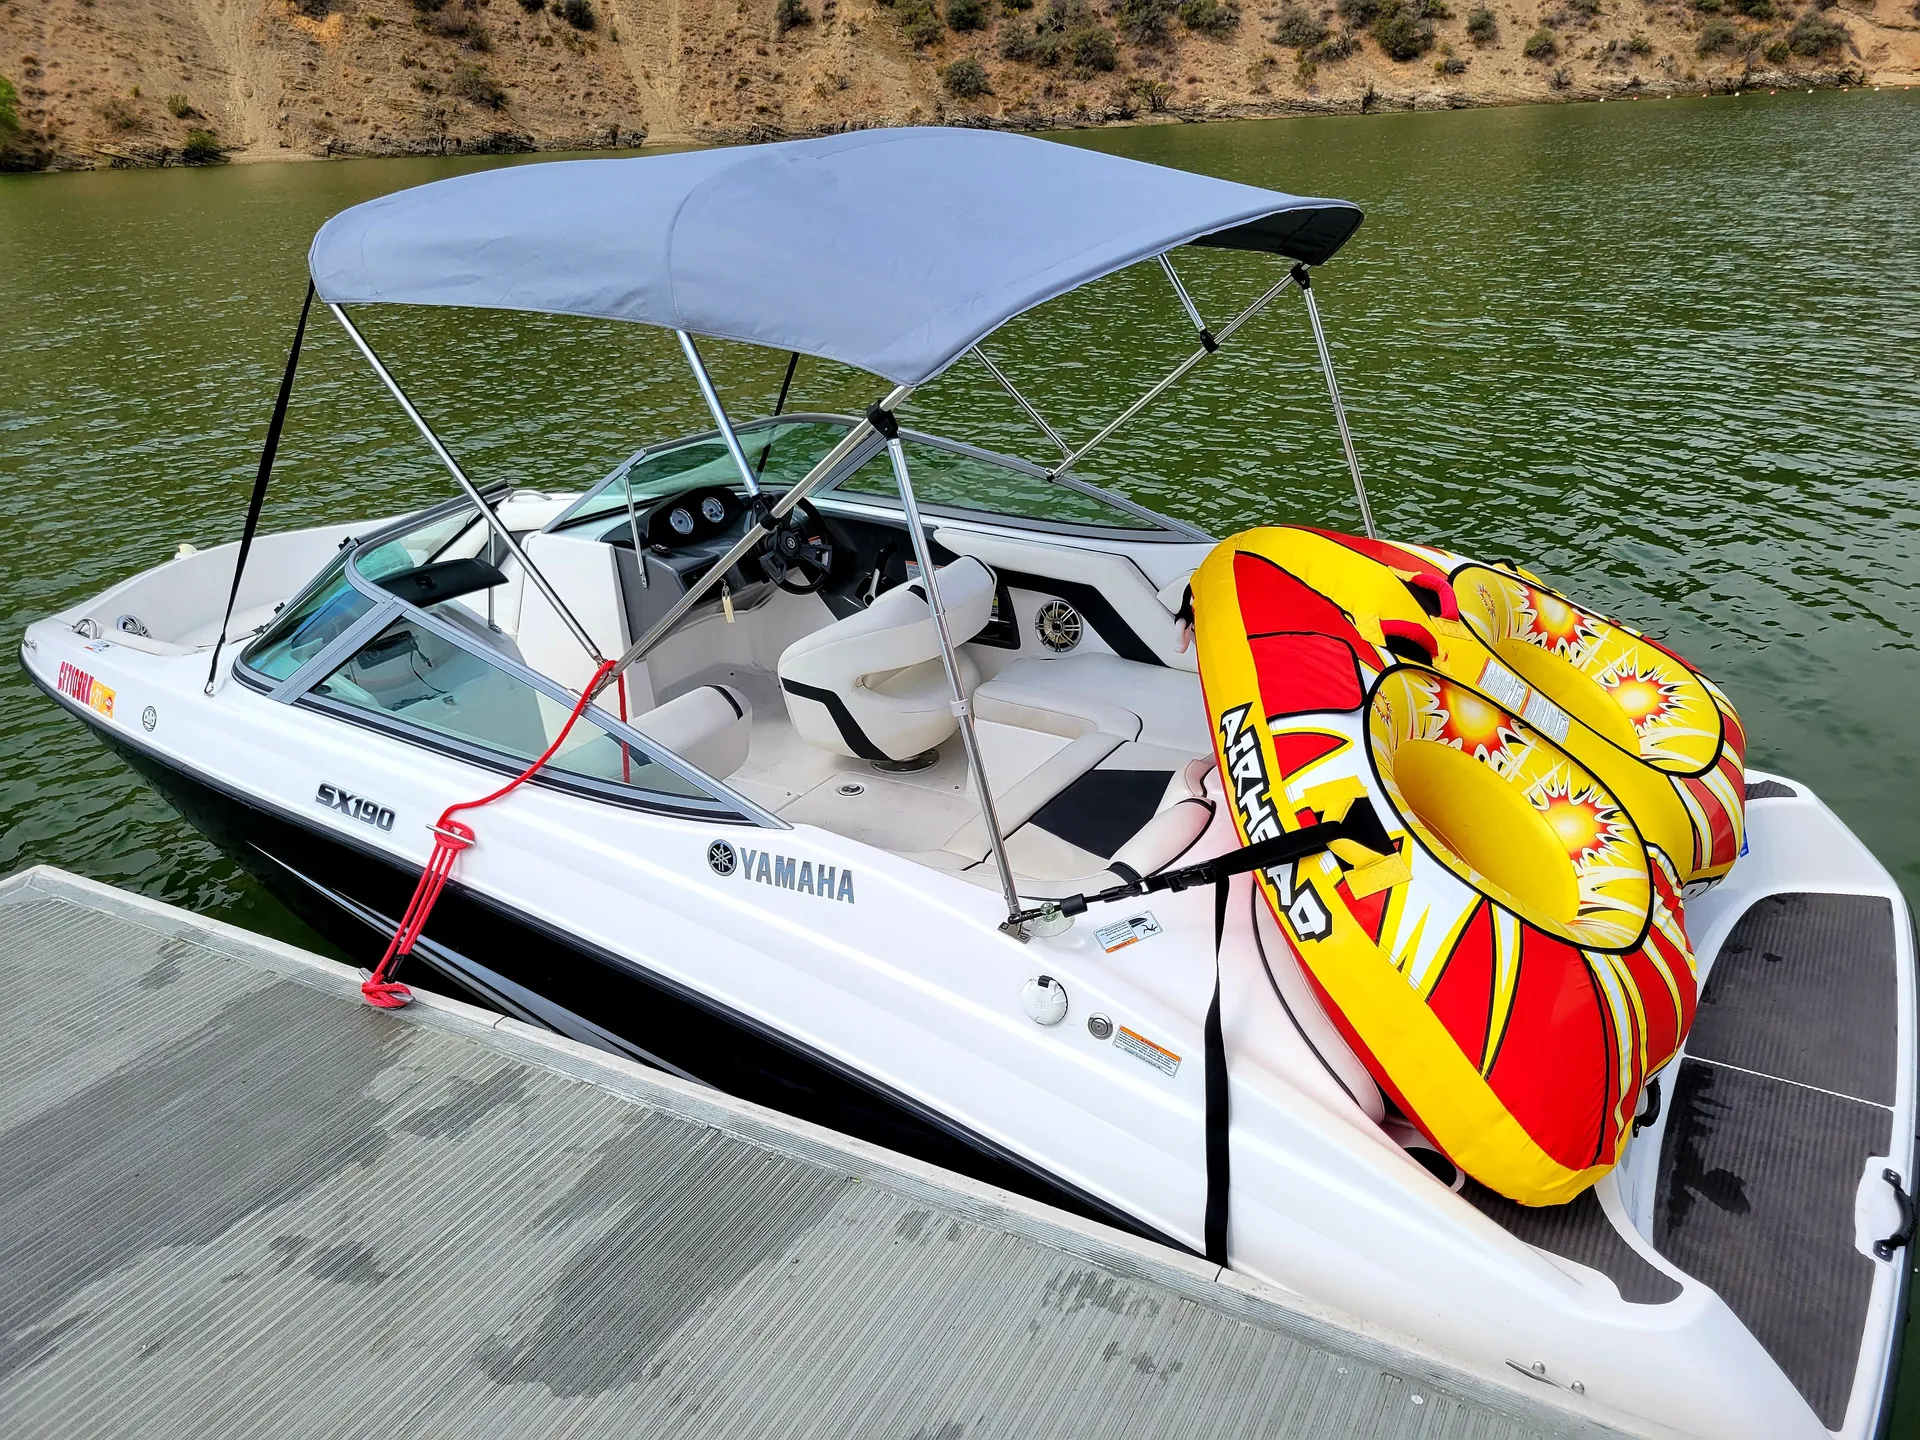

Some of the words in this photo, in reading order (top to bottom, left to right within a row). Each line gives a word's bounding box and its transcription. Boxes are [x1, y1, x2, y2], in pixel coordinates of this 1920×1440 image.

[315, 782, 396, 832] SX190
[1219, 703, 1331, 942] AIRHEAD
[740, 847, 855, 904] YAMAHA
